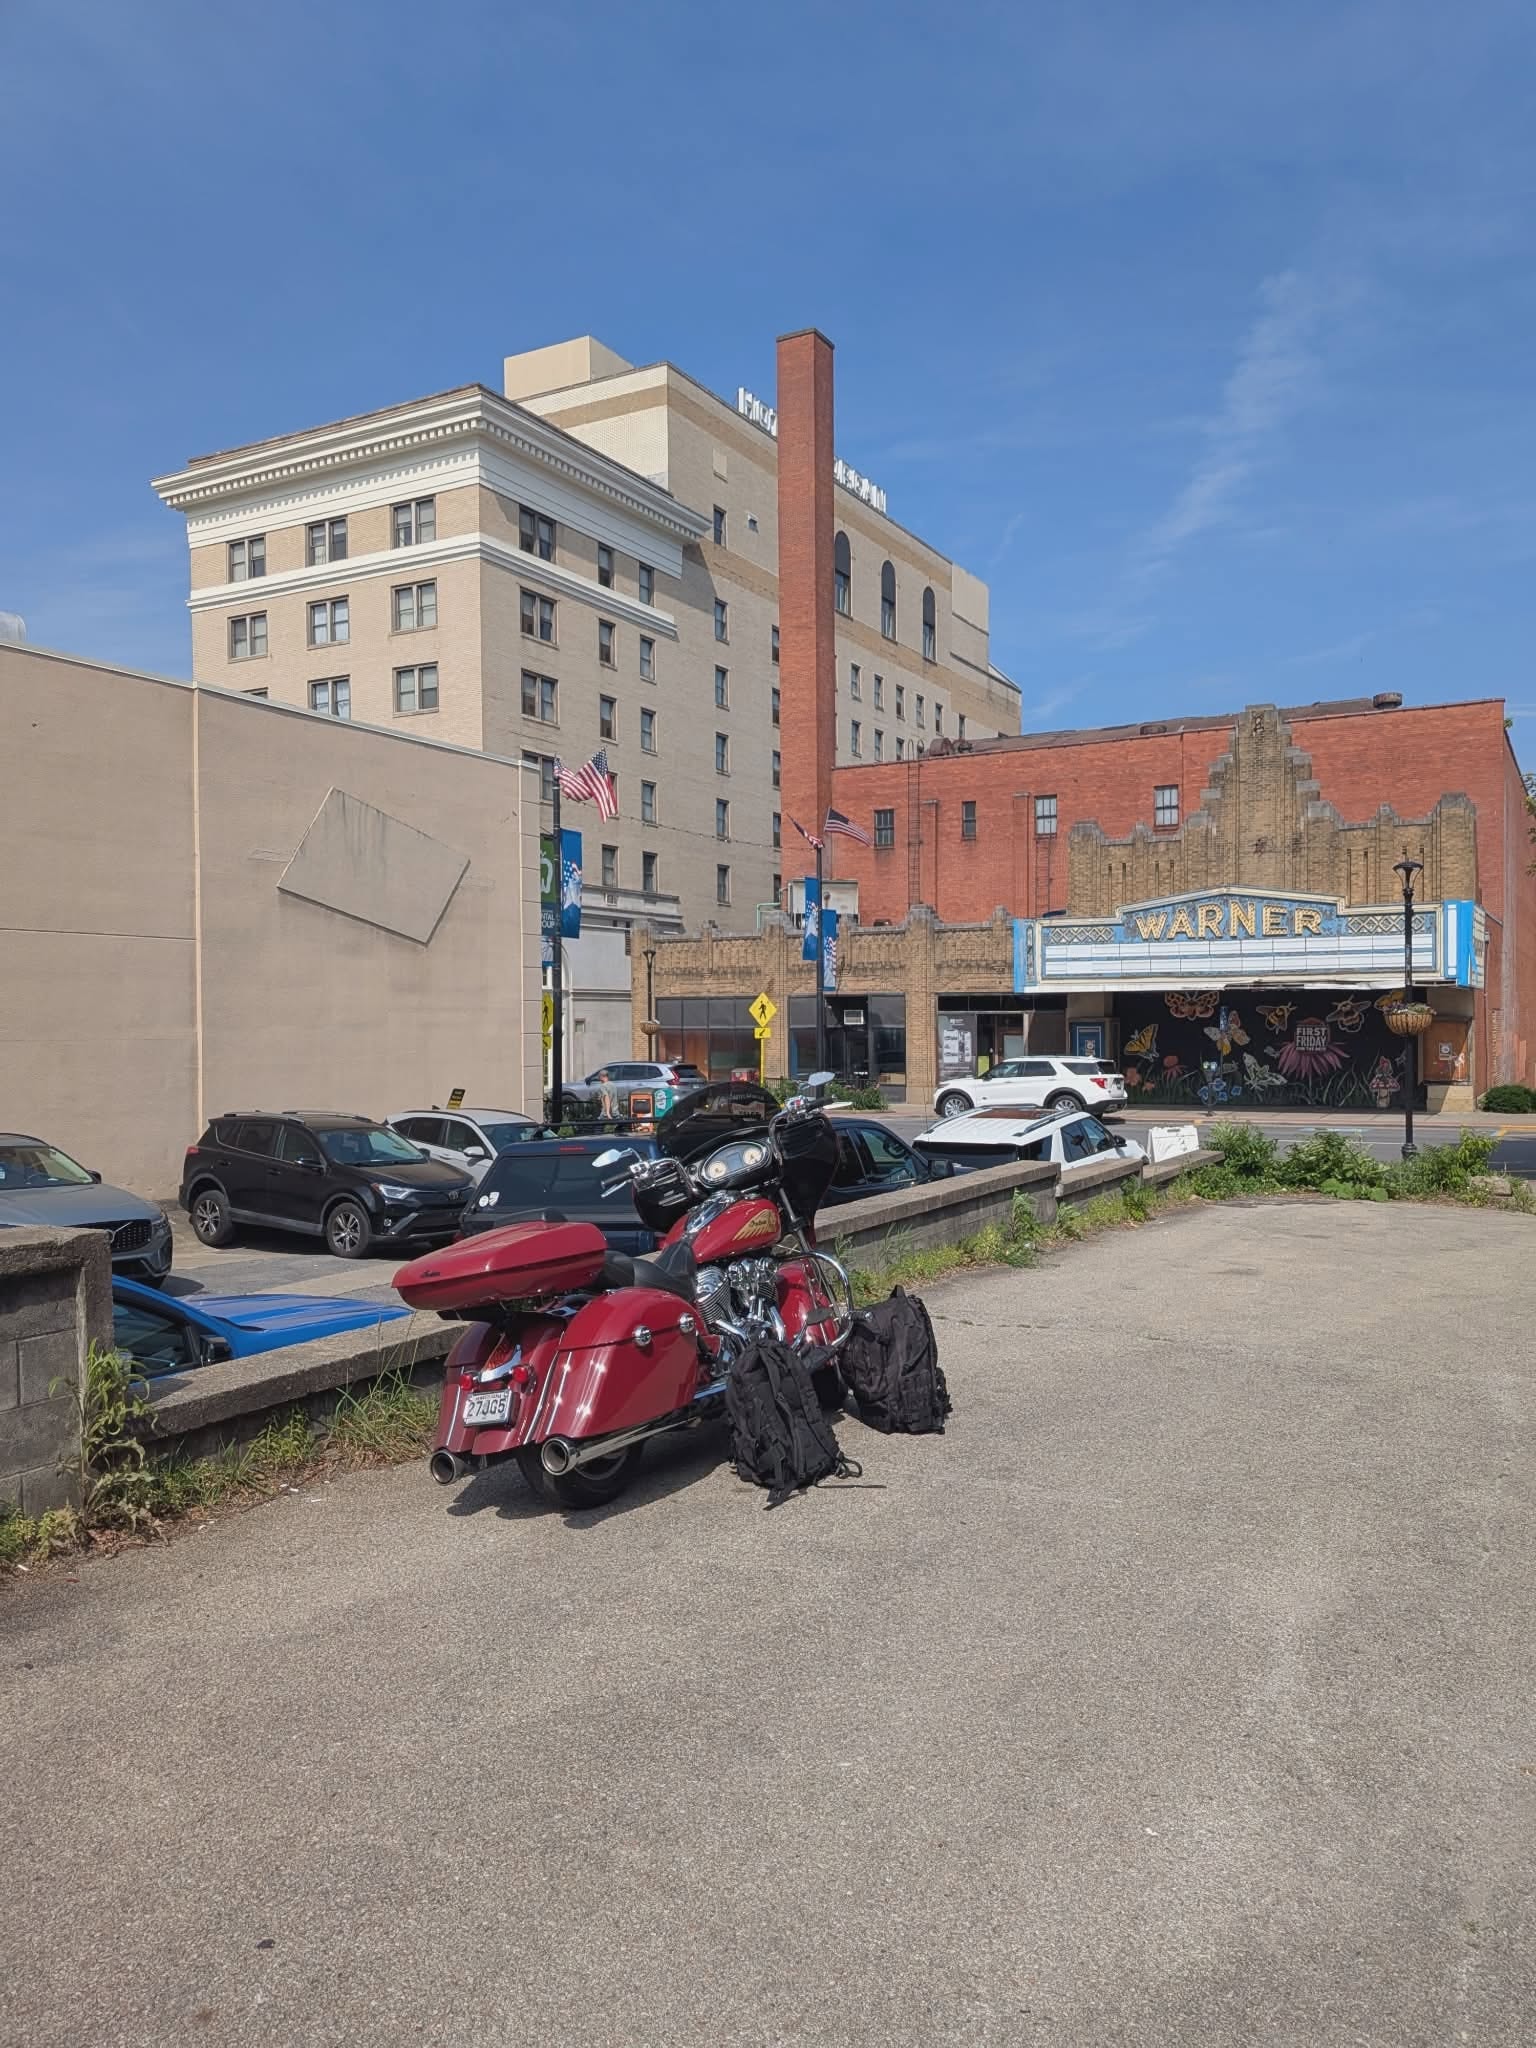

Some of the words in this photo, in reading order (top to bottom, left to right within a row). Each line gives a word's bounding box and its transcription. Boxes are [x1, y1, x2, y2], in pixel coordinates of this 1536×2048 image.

[1136, 901, 1322, 940] WARNER
[1296, 1027, 1327, 1036] FIRST
[1296, 1036, 1327, 1047] FRIDAY
